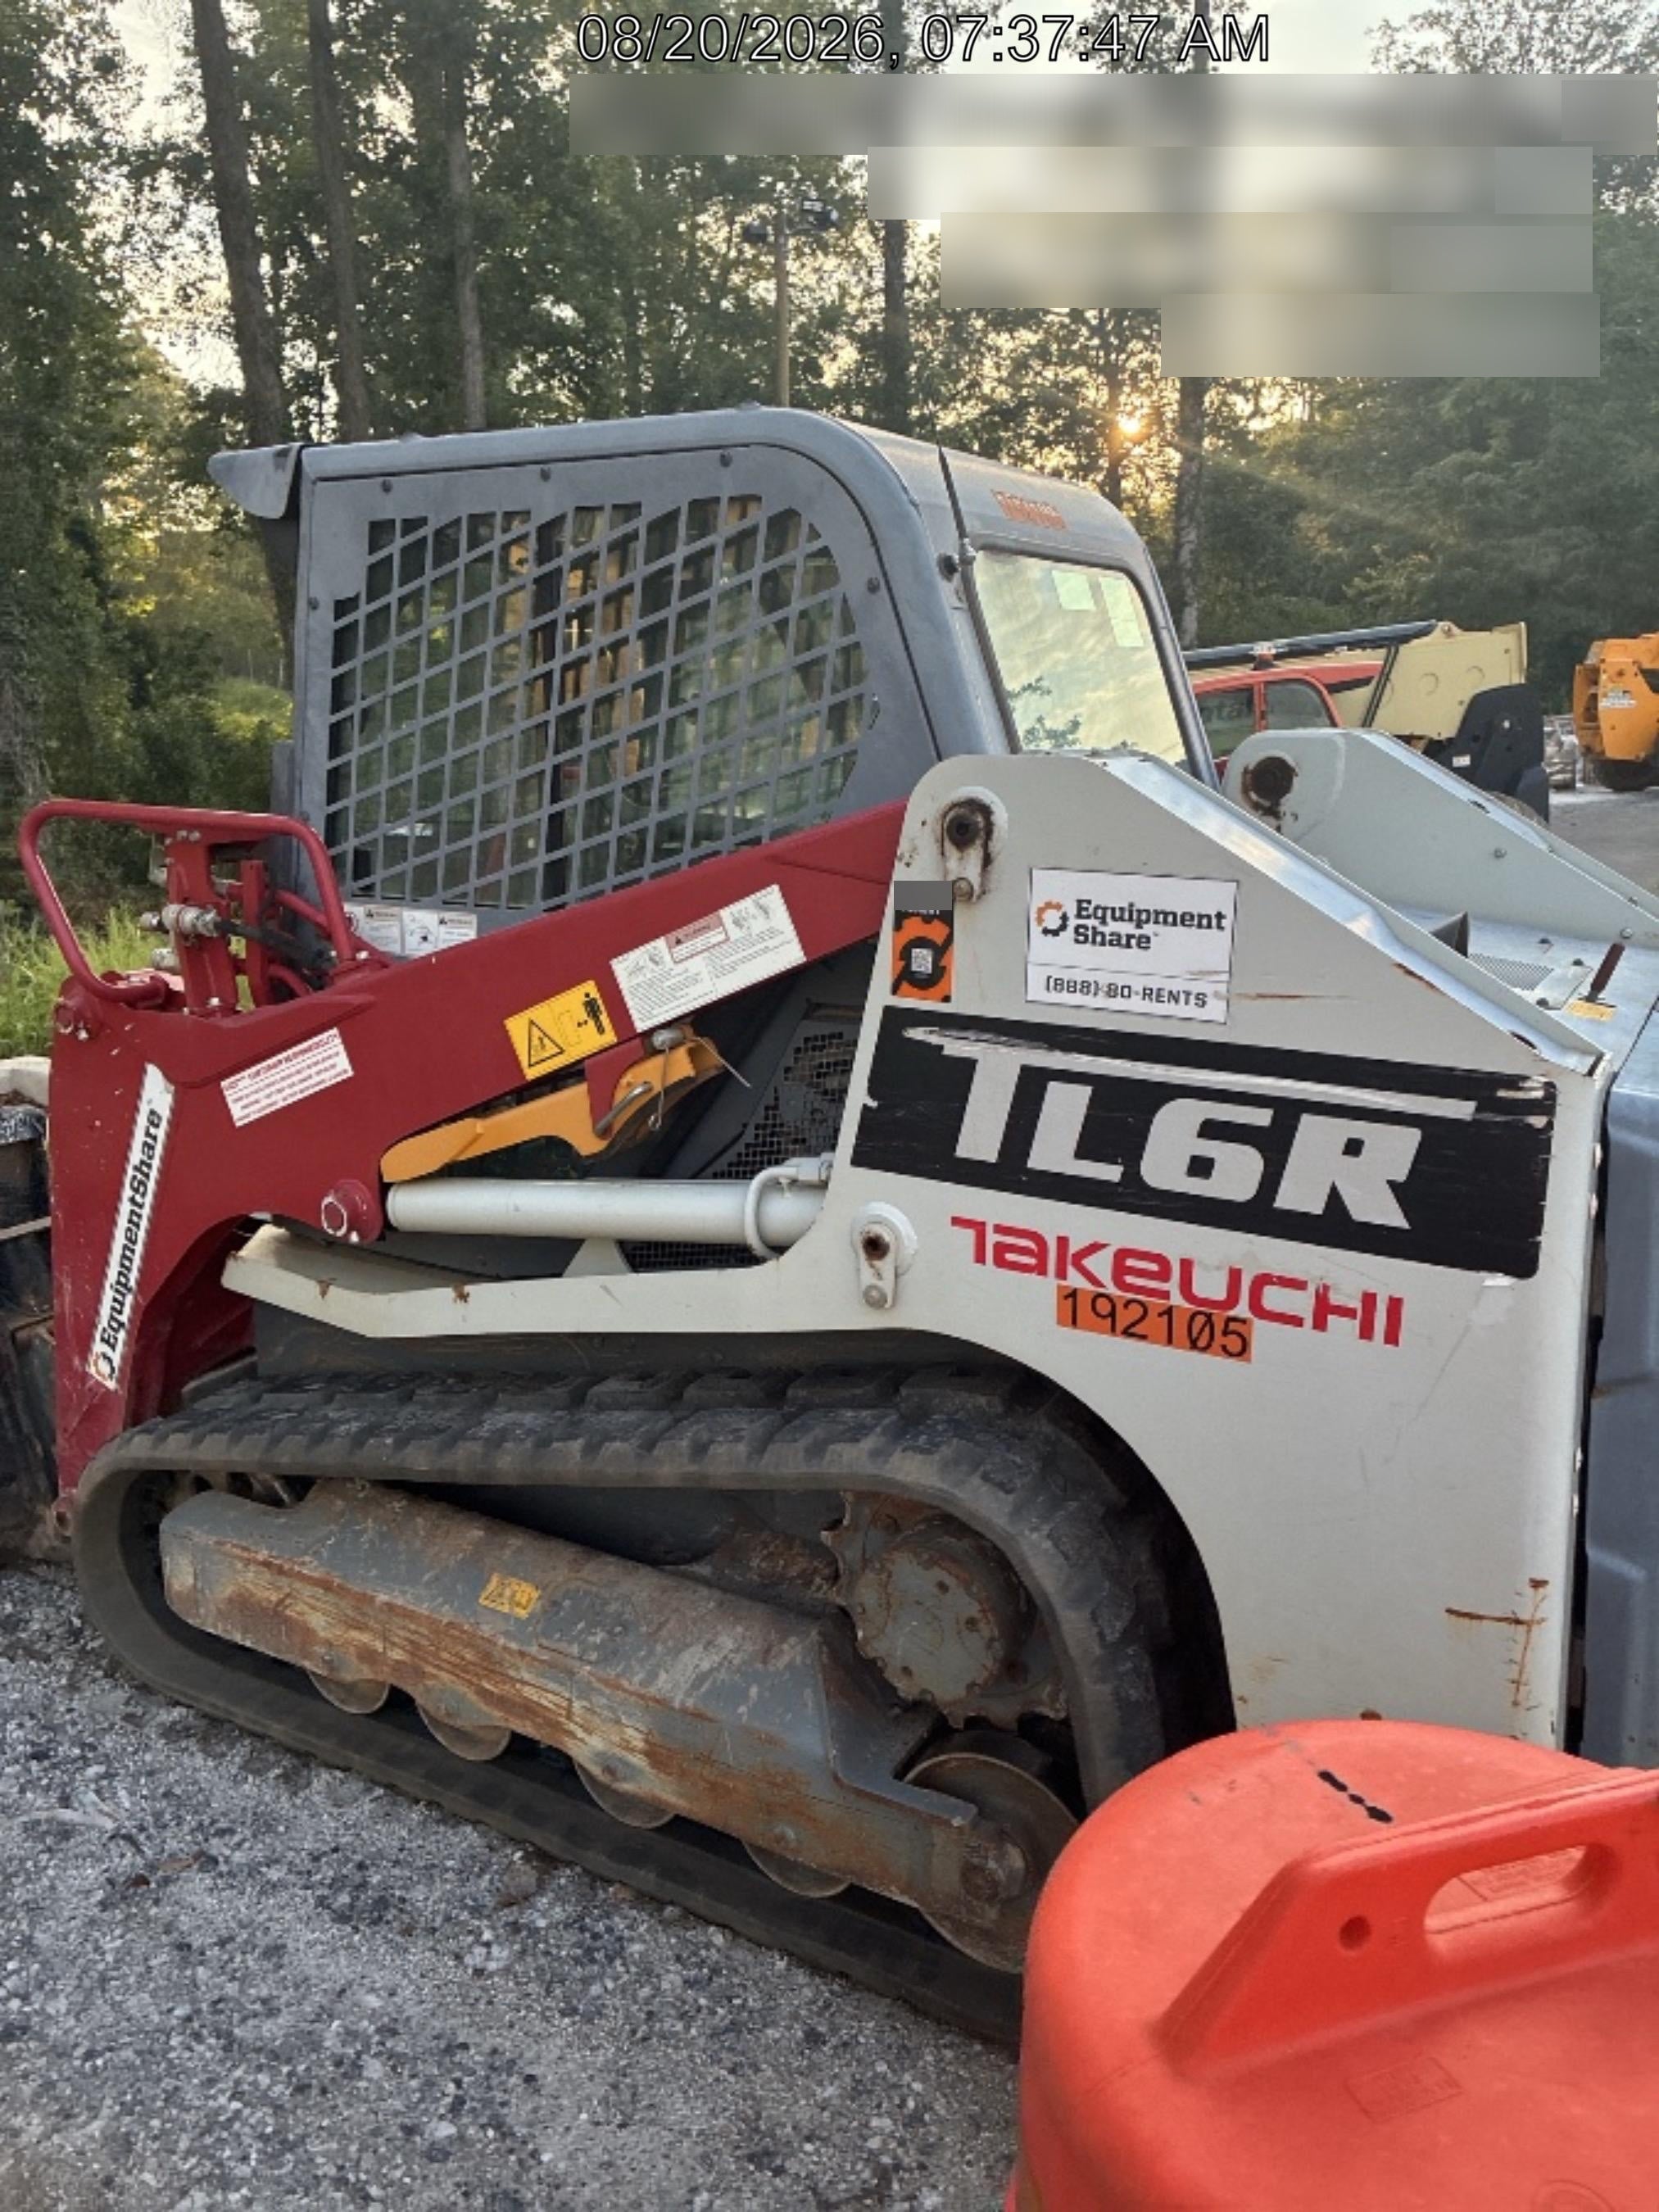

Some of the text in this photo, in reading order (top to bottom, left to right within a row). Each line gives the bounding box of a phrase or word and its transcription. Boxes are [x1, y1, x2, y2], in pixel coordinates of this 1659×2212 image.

[1074, 899, 1226, 931] Equipment
[904, 1026, 1477, 1231] TL6R
[99, 1108, 164, 1352] EquipmentShare
[1062, 1287, 1250, 1359] 192105
